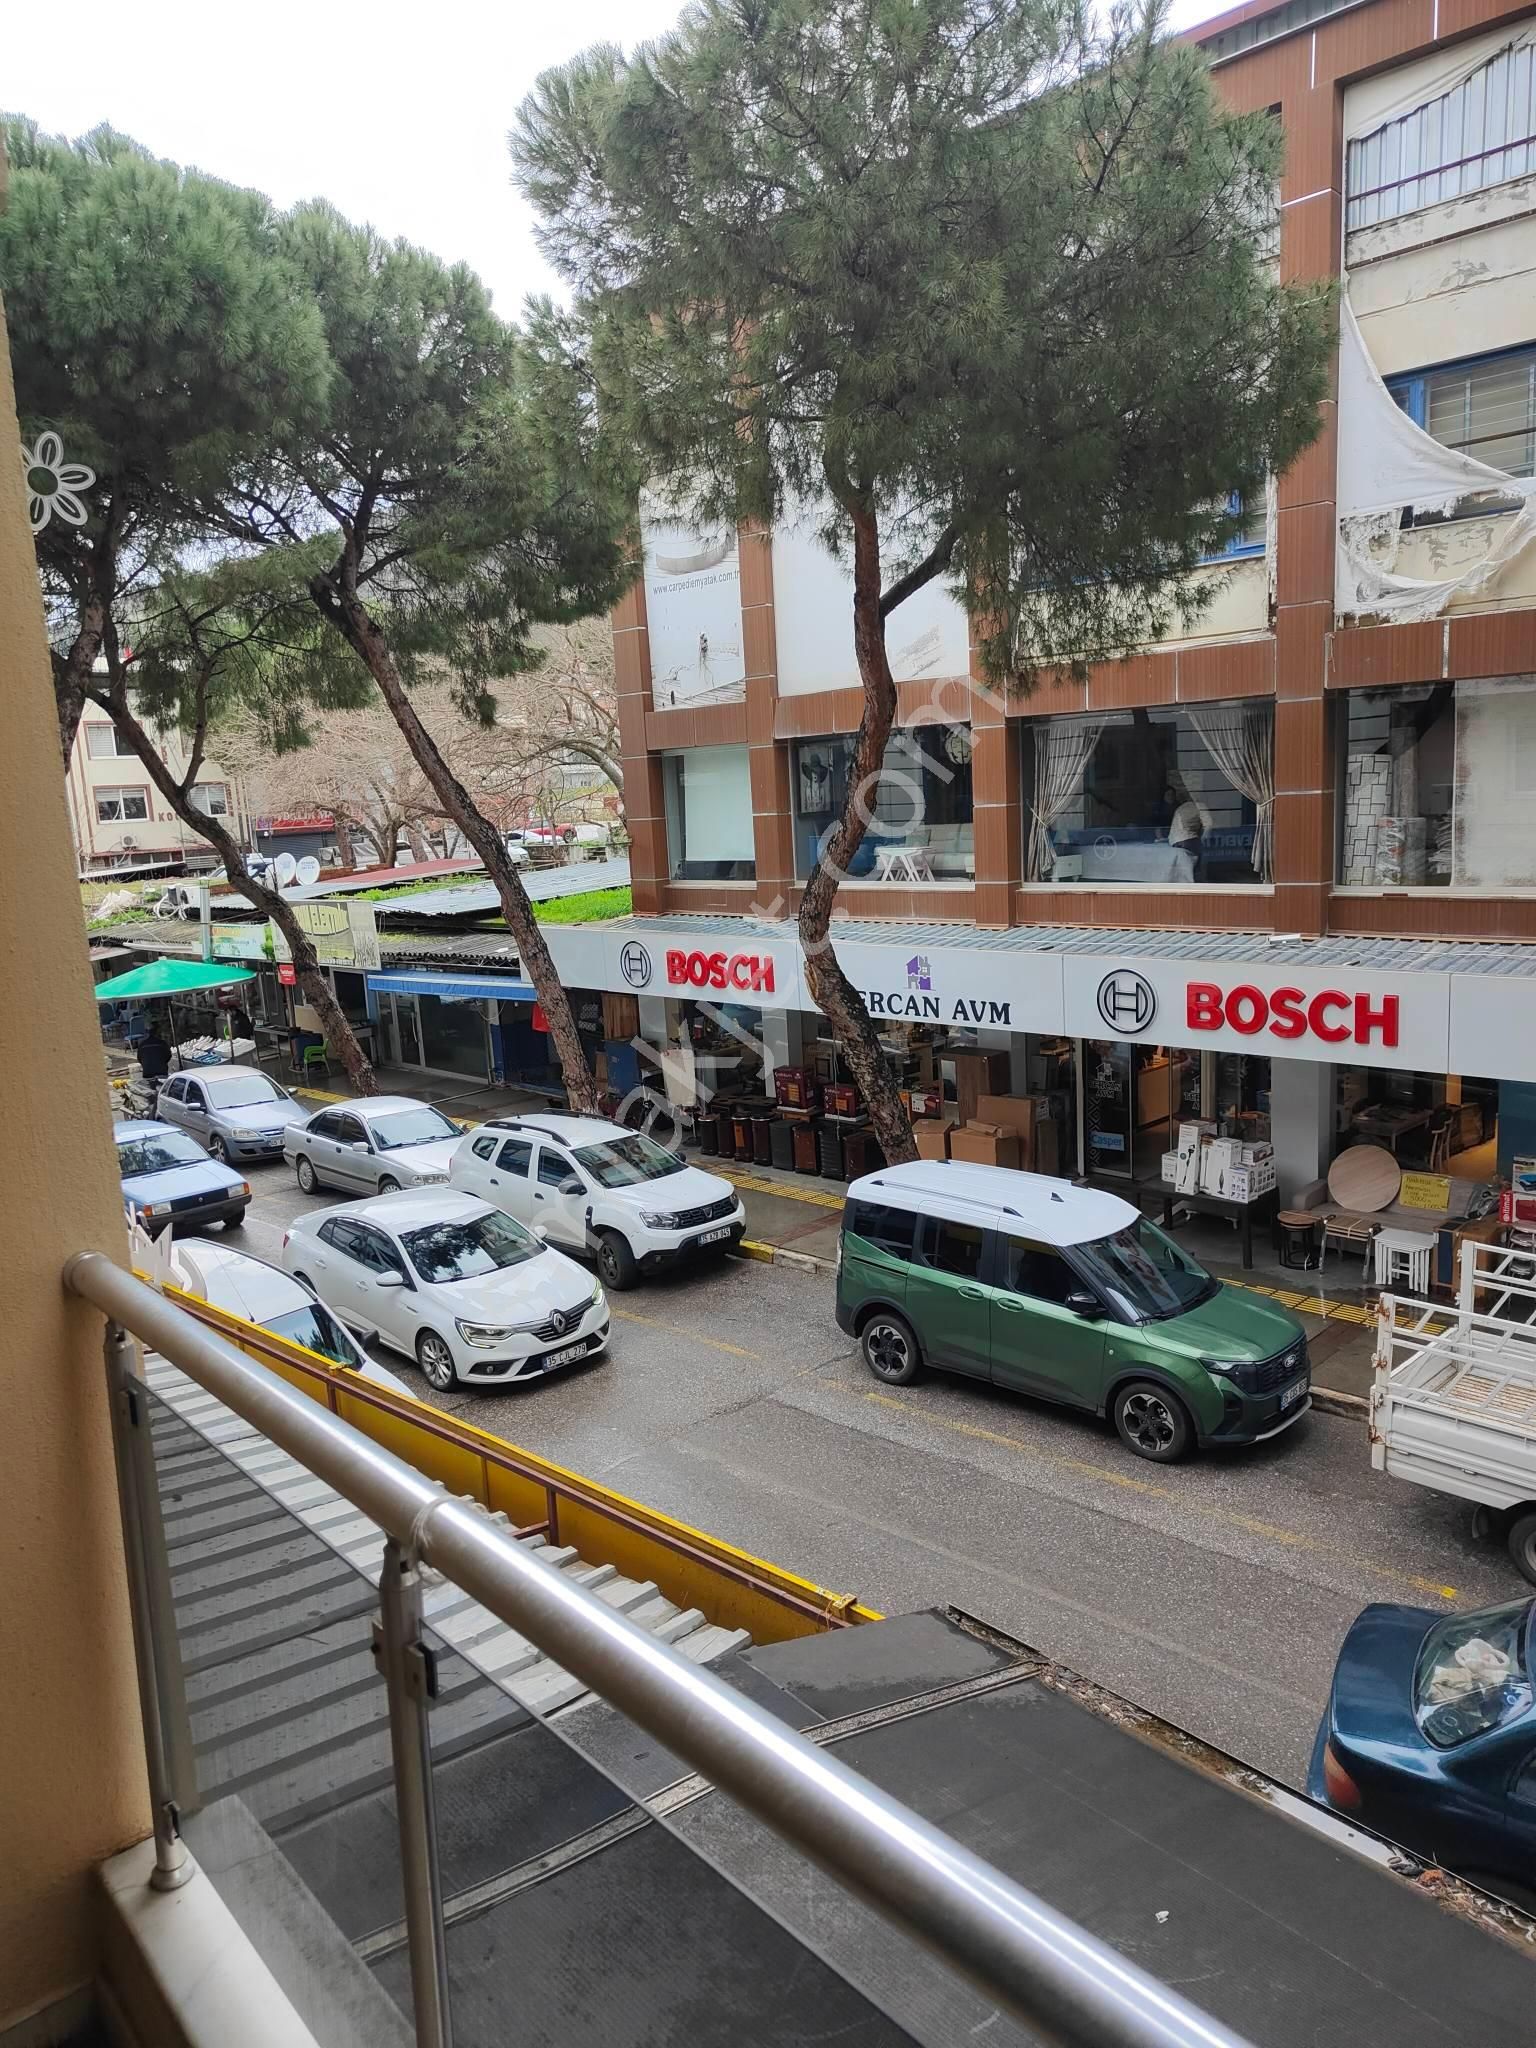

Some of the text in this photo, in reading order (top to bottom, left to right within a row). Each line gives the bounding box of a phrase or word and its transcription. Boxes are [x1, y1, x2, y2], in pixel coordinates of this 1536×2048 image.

[666, 949, 775, 992] BOSCH
[952, 999, 1012, 1025] AVM
[1186, 981, 1400, 1047] BOSCH
[547, 1355, 557, 1366] 35
[573, 1344, 586, 1356] 279
